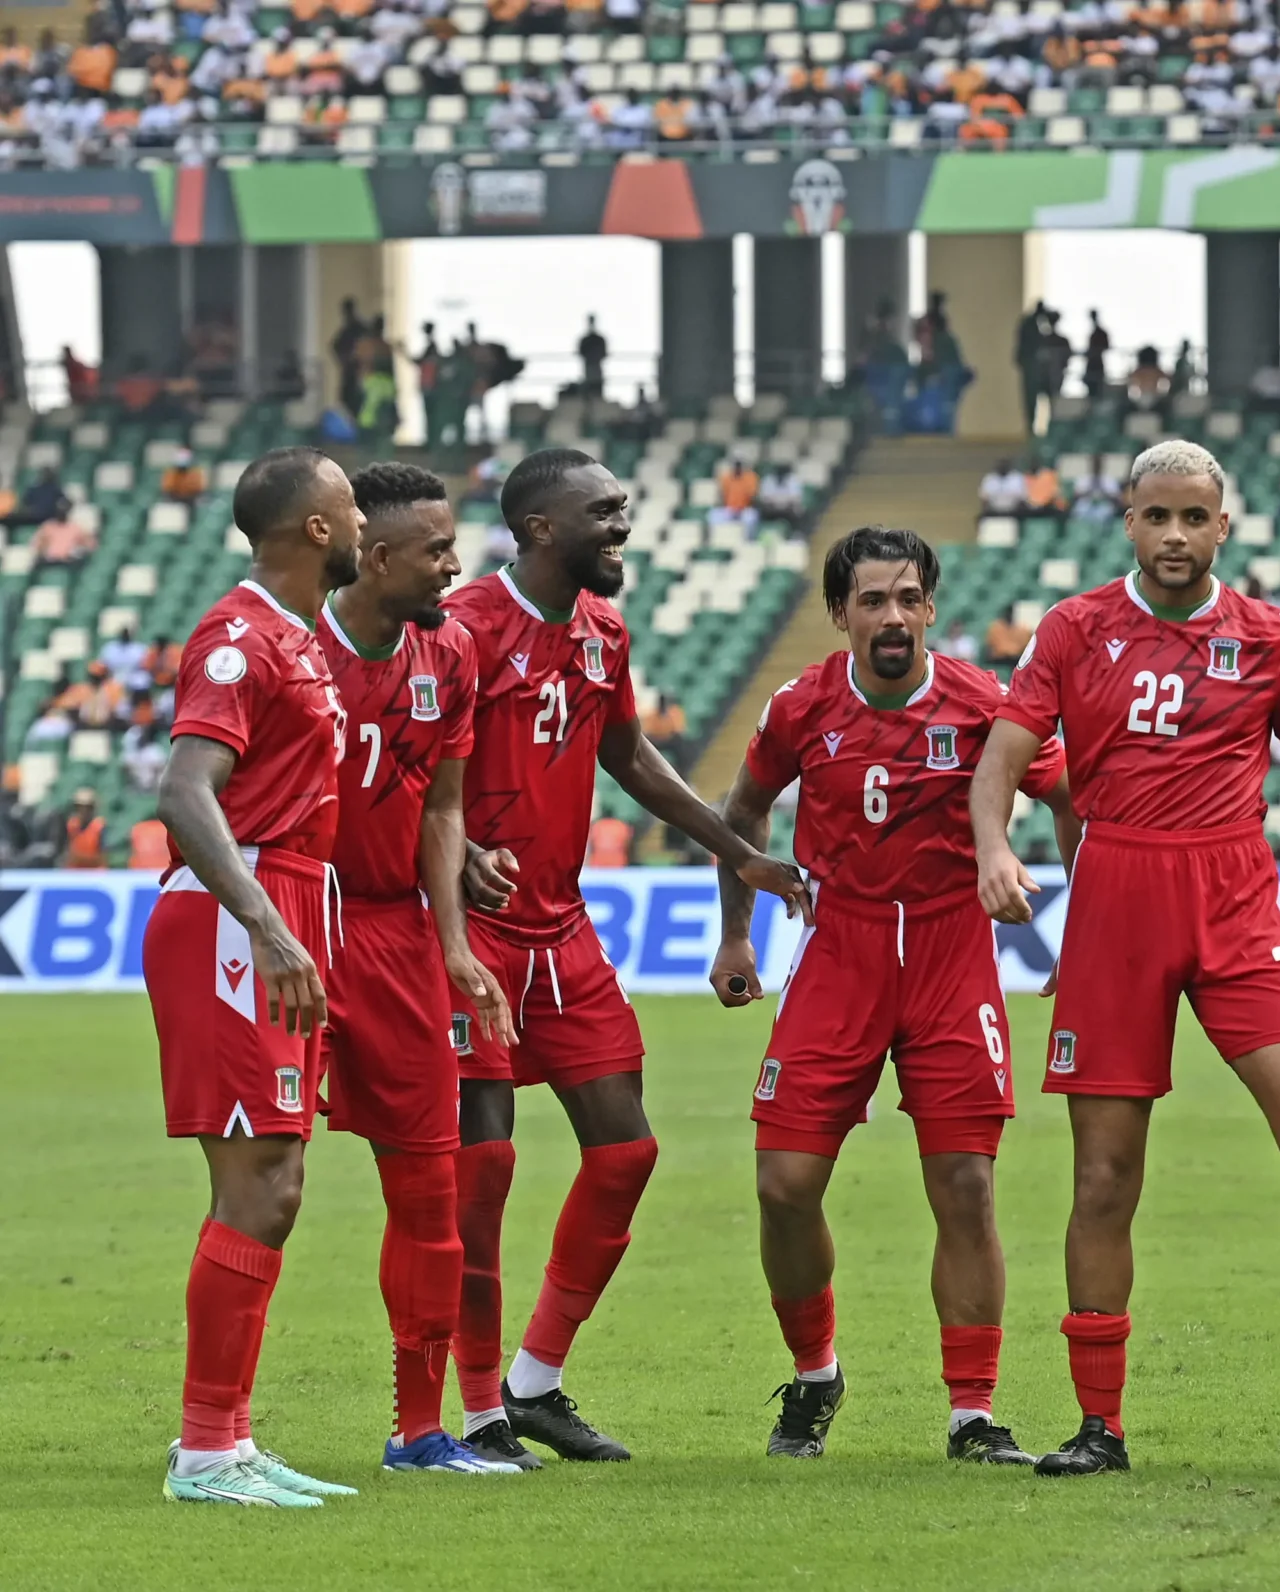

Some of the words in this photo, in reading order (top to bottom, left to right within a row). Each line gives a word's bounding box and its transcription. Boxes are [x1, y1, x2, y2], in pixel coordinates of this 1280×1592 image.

[533, 679, 568, 744] 21
[1127, 670, 1185, 737] 22
[359, 722, 381, 788] 7
[863, 764, 889, 824] 6
[978, 1003, 1004, 1064] 6
